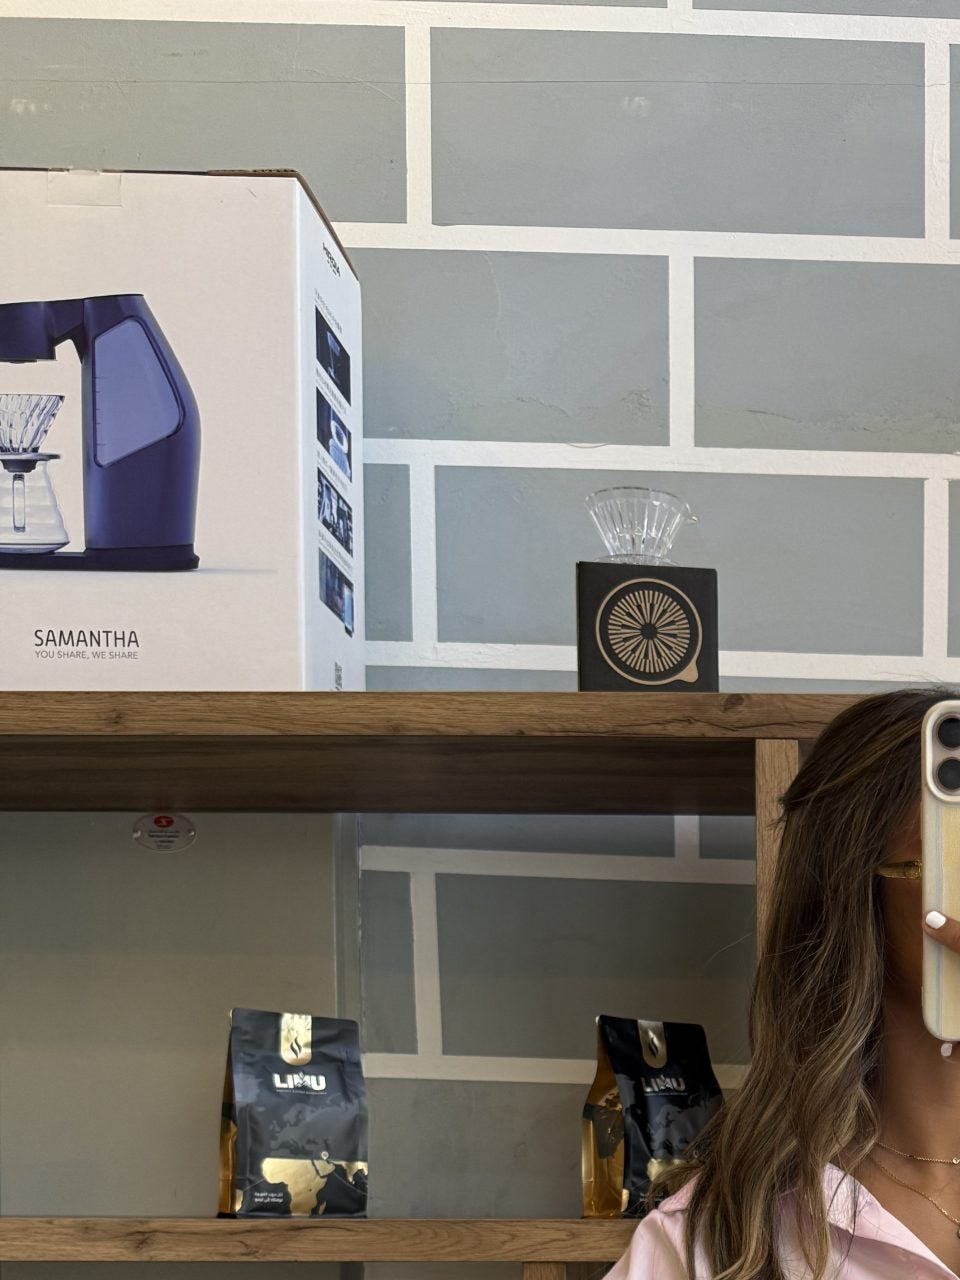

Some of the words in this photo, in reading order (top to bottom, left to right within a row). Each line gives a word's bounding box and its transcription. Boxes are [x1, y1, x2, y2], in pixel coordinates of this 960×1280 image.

[34, 629, 139, 648] SAMANTHA
[35, 650, 55, 659] YOU
[57, 650, 90, 660] SHARE,
[92, 651, 106, 660] WE
[108, 651, 138, 660] SHARE
[272, 1071, 326, 1091] LIMU
[641, 1074, 686, 1092] LIMU
